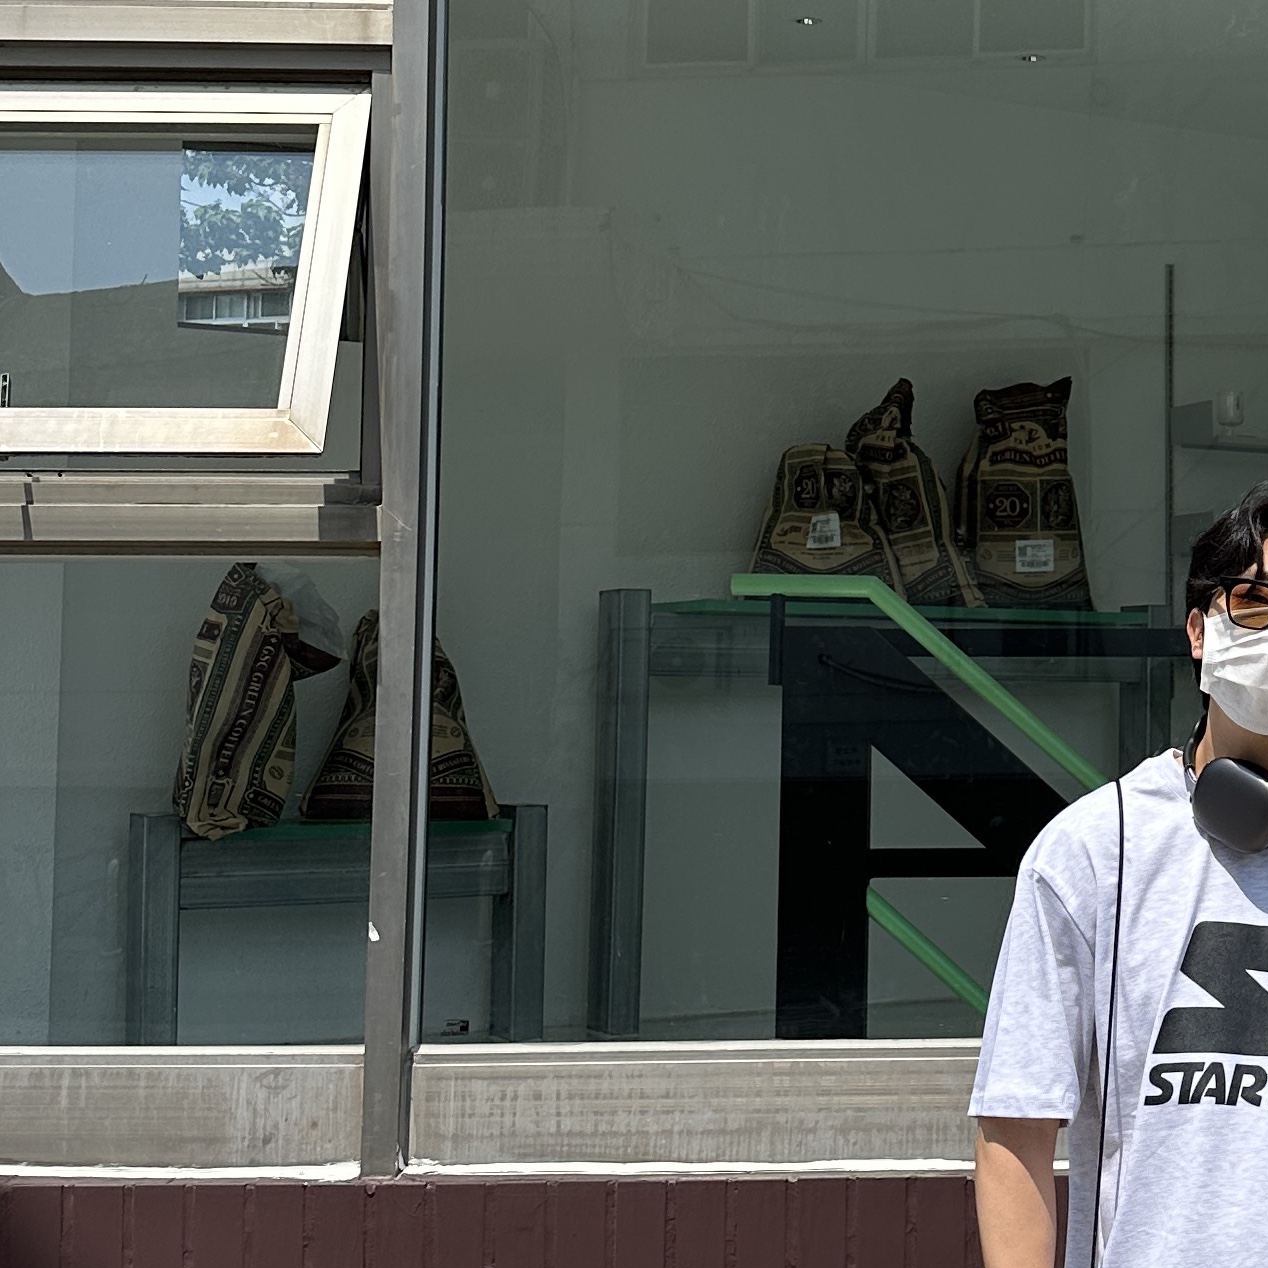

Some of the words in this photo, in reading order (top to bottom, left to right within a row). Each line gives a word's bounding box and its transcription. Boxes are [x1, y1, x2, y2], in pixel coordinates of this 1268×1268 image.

[800, 477, 817, 499] 20
[995, 496, 1020, 516] 20
[255, 645, 275, 673] GSC
[240, 672, 264, 715] GREEN
[218, 715, 247, 764] COFFEE
